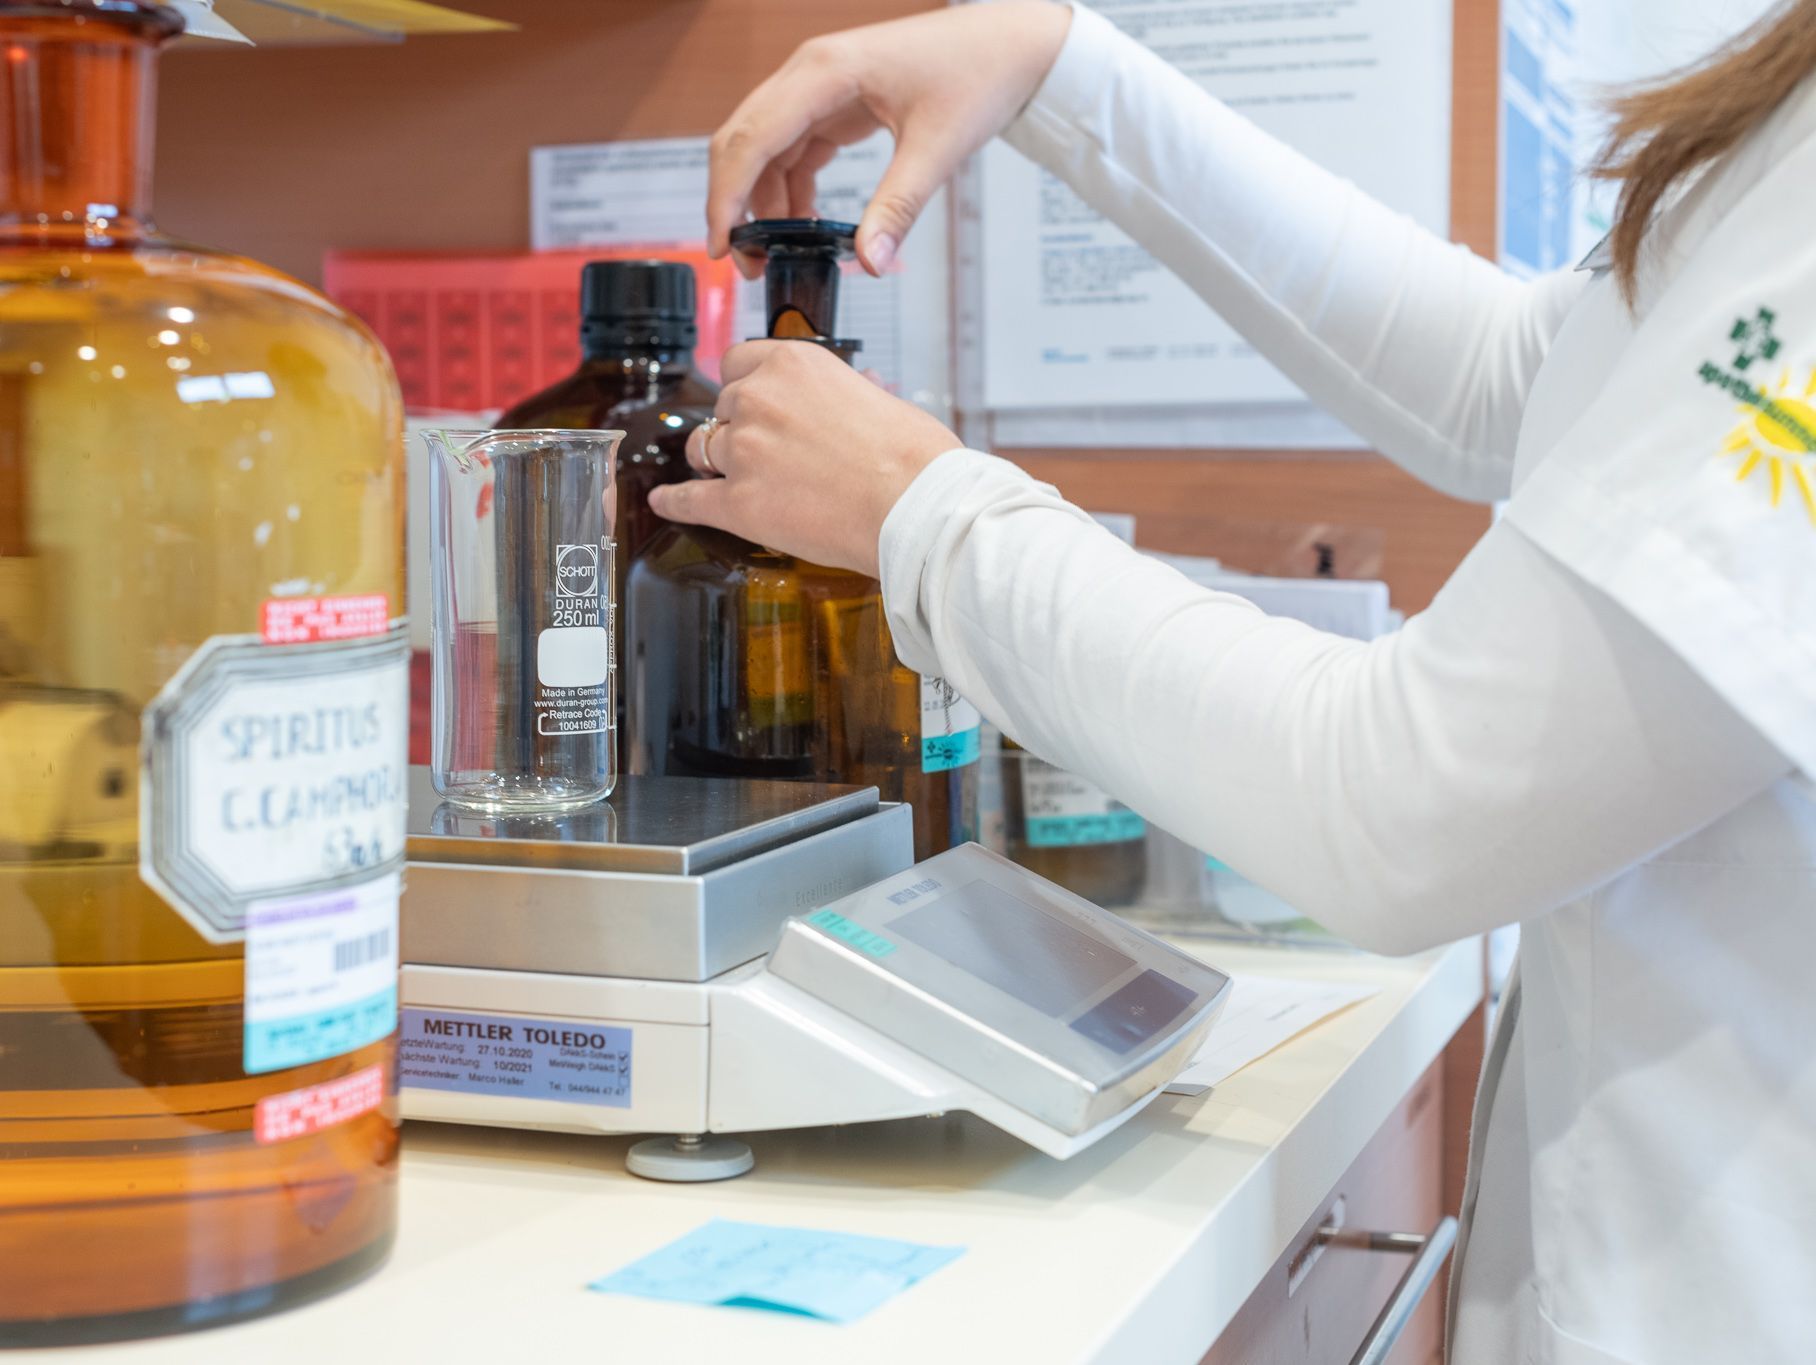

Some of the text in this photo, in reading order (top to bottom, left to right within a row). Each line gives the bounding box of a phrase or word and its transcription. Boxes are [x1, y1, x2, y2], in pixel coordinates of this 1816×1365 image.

[559, 566, 596, 578] SCHOTT
[555, 598, 598, 610] DURAN
[553, 609, 600, 627] 250 ml
[541, 687, 606, 698] Made in Germany
[549, 708, 602, 720] Retrace Code
[221, 701, 381, 763] SPIRITUS
[559, 720, 597, 732] 10041609
[423, 1018, 606, 1050] METTLER TOLEDO
[478, 1044, 534, 1059] 27.10.2020
[494, 1061, 533, 1073] 10/2021
[468, 1072, 497, 1084] Marco
